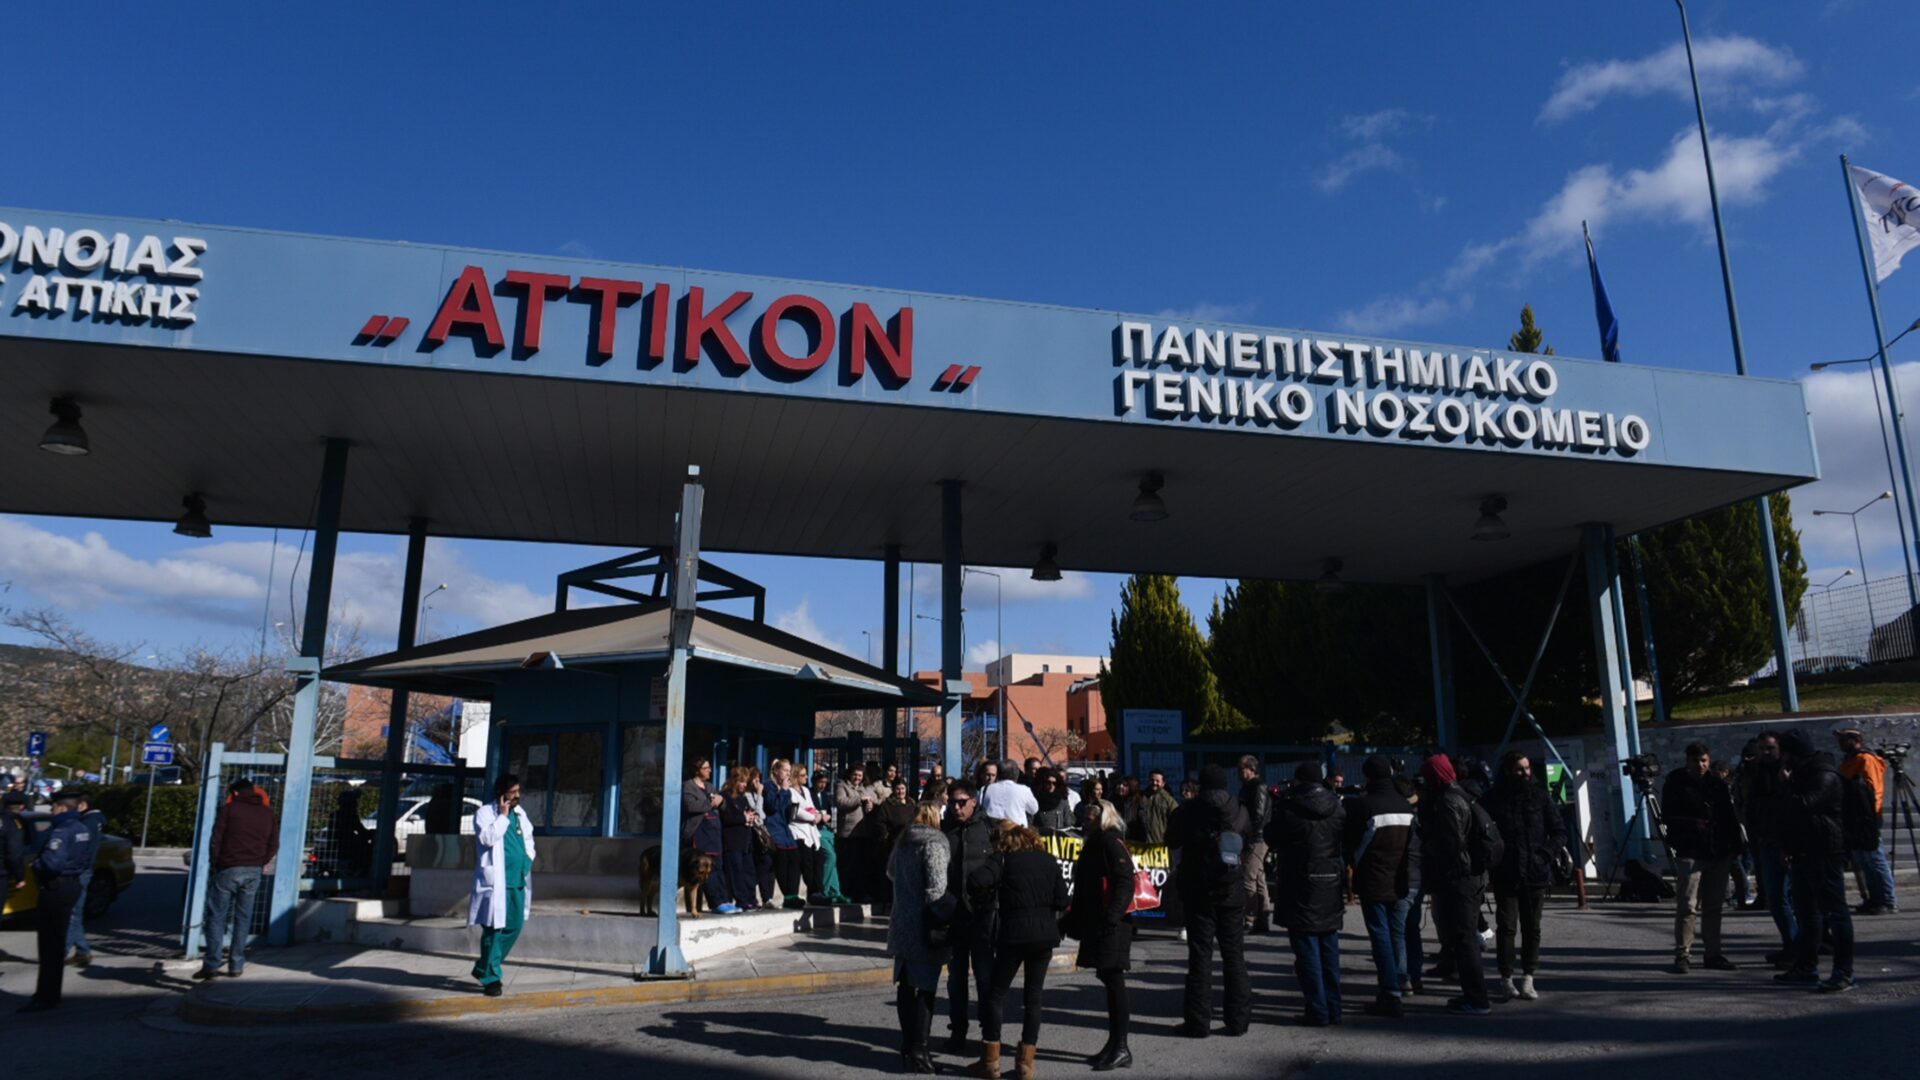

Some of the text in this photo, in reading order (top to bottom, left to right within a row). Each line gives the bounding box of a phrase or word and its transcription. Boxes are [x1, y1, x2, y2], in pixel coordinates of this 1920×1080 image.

[18, 275, 200, 323] ΑΤΤΙΚΗΣ
[1119, 321, 1558, 398] ΠΑΝΕΠΙΣΤΗΜΙΑΚΟ
[1121, 369, 1651, 451] ΓΕΝΙΚΟ ΝΟΣΟΚΟΜΕΙΟ
